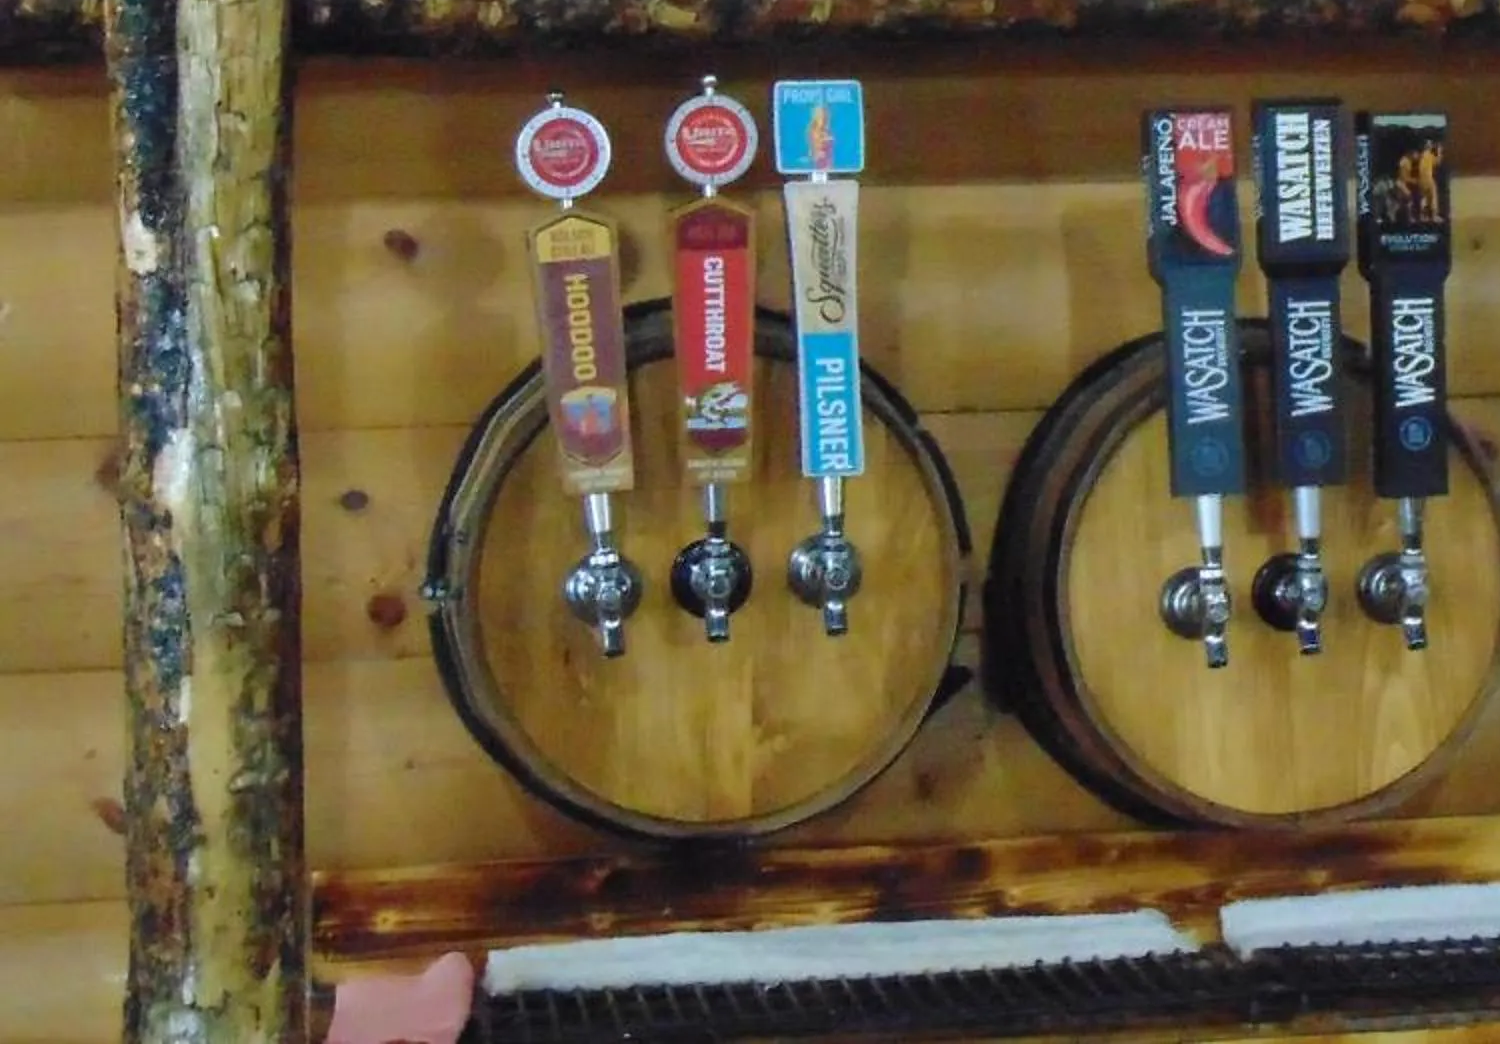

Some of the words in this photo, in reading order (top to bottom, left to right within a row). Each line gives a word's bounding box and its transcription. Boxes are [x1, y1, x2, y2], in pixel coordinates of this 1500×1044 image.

[1178, 131, 1230, 150] ALE
[1276, 112, 1312, 243] WASATCH
[1313, 119, 1334, 241] HEFEWEIZEN
[564, 273, 597, 381] HOODOO
[703, 256, 726, 373] CUTTHROAT
[1181, 309, 1230, 424] WASATCH
[1288, 299, 1334, 417] WASATCH
[1392, 297, 1436, 407] WASATCH
[815, 357, 851, 470] PILSNER
